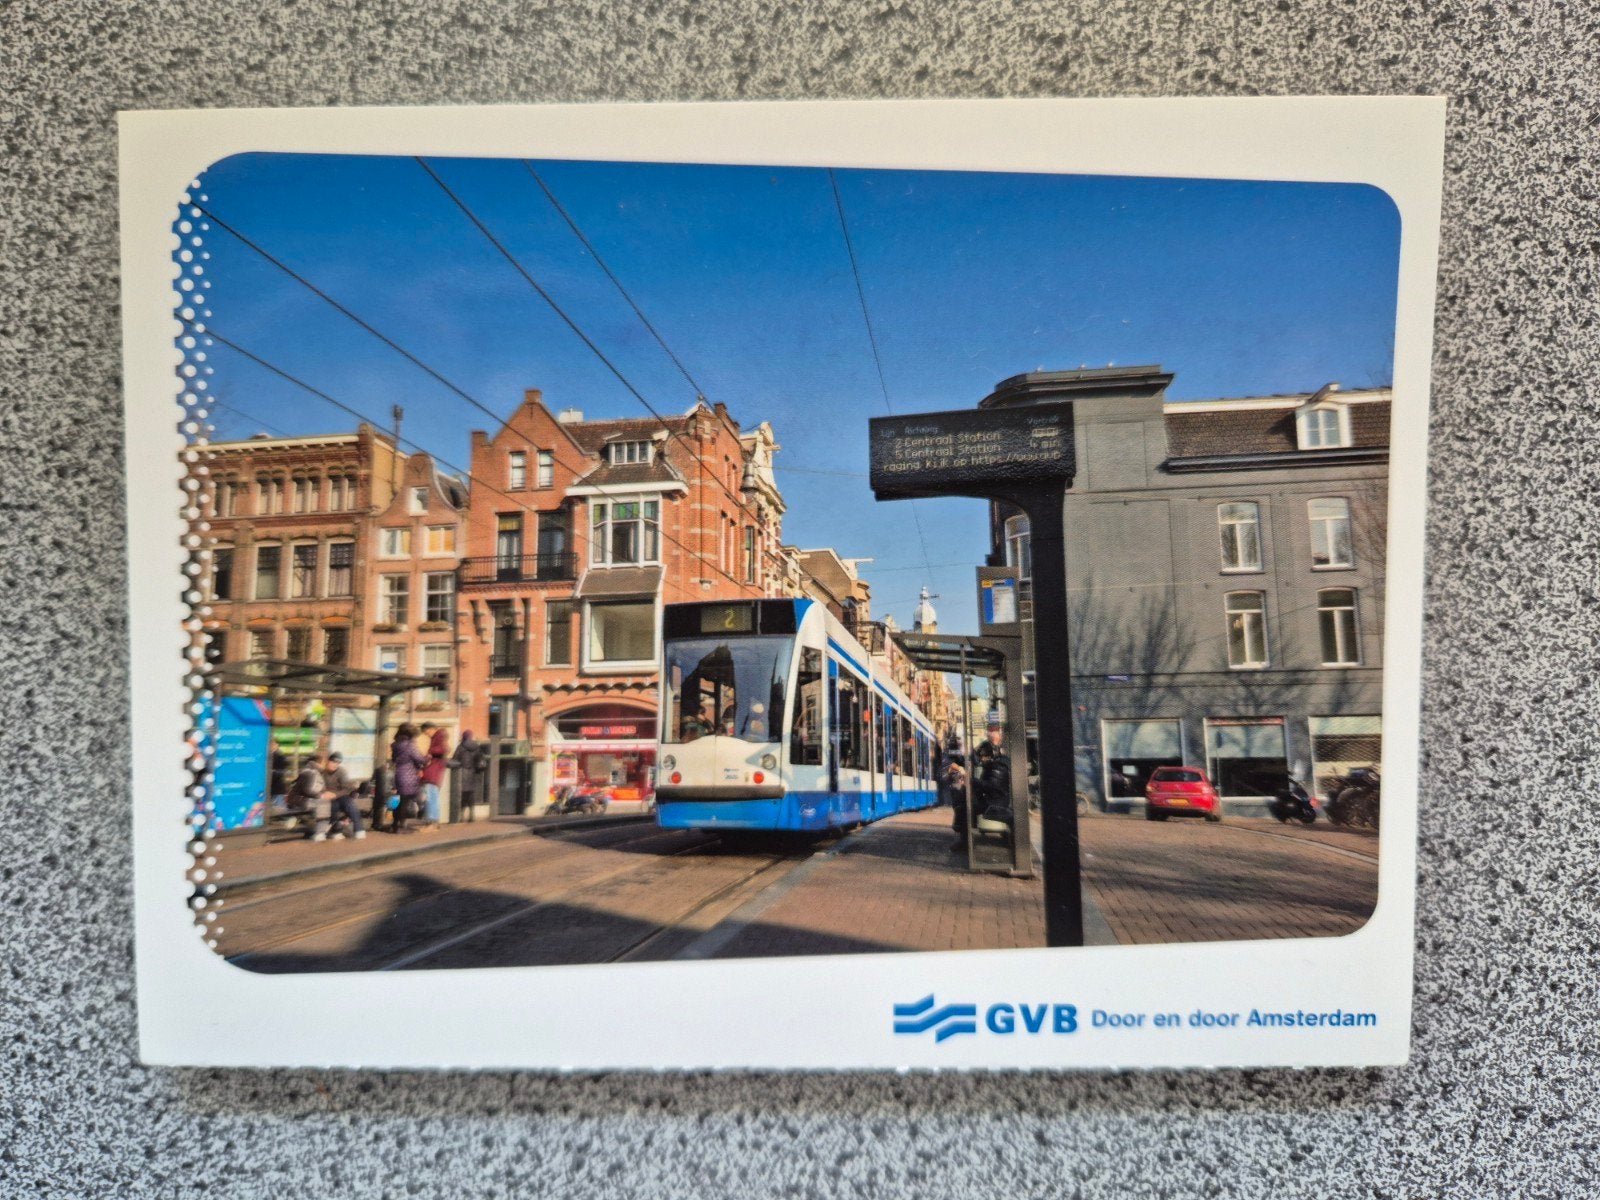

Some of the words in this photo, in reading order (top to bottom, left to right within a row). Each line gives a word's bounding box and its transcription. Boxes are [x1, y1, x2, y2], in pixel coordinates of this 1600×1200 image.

[905, 434, 953, 447] Centraal
[958, 431, 1001, 443] Station
[905, 446, 953, 459] Centraal
[958, 443, 1001, 455] Station
[984, 1003, 1078, 1035] GVB
[1091, 1008, 1147, 1028] Door
[1152, 1012, 1182, 1028] en
[1187, 1008, 1240, 1028] door
[1246, 1008, 1378, 1028] Amsterdam
